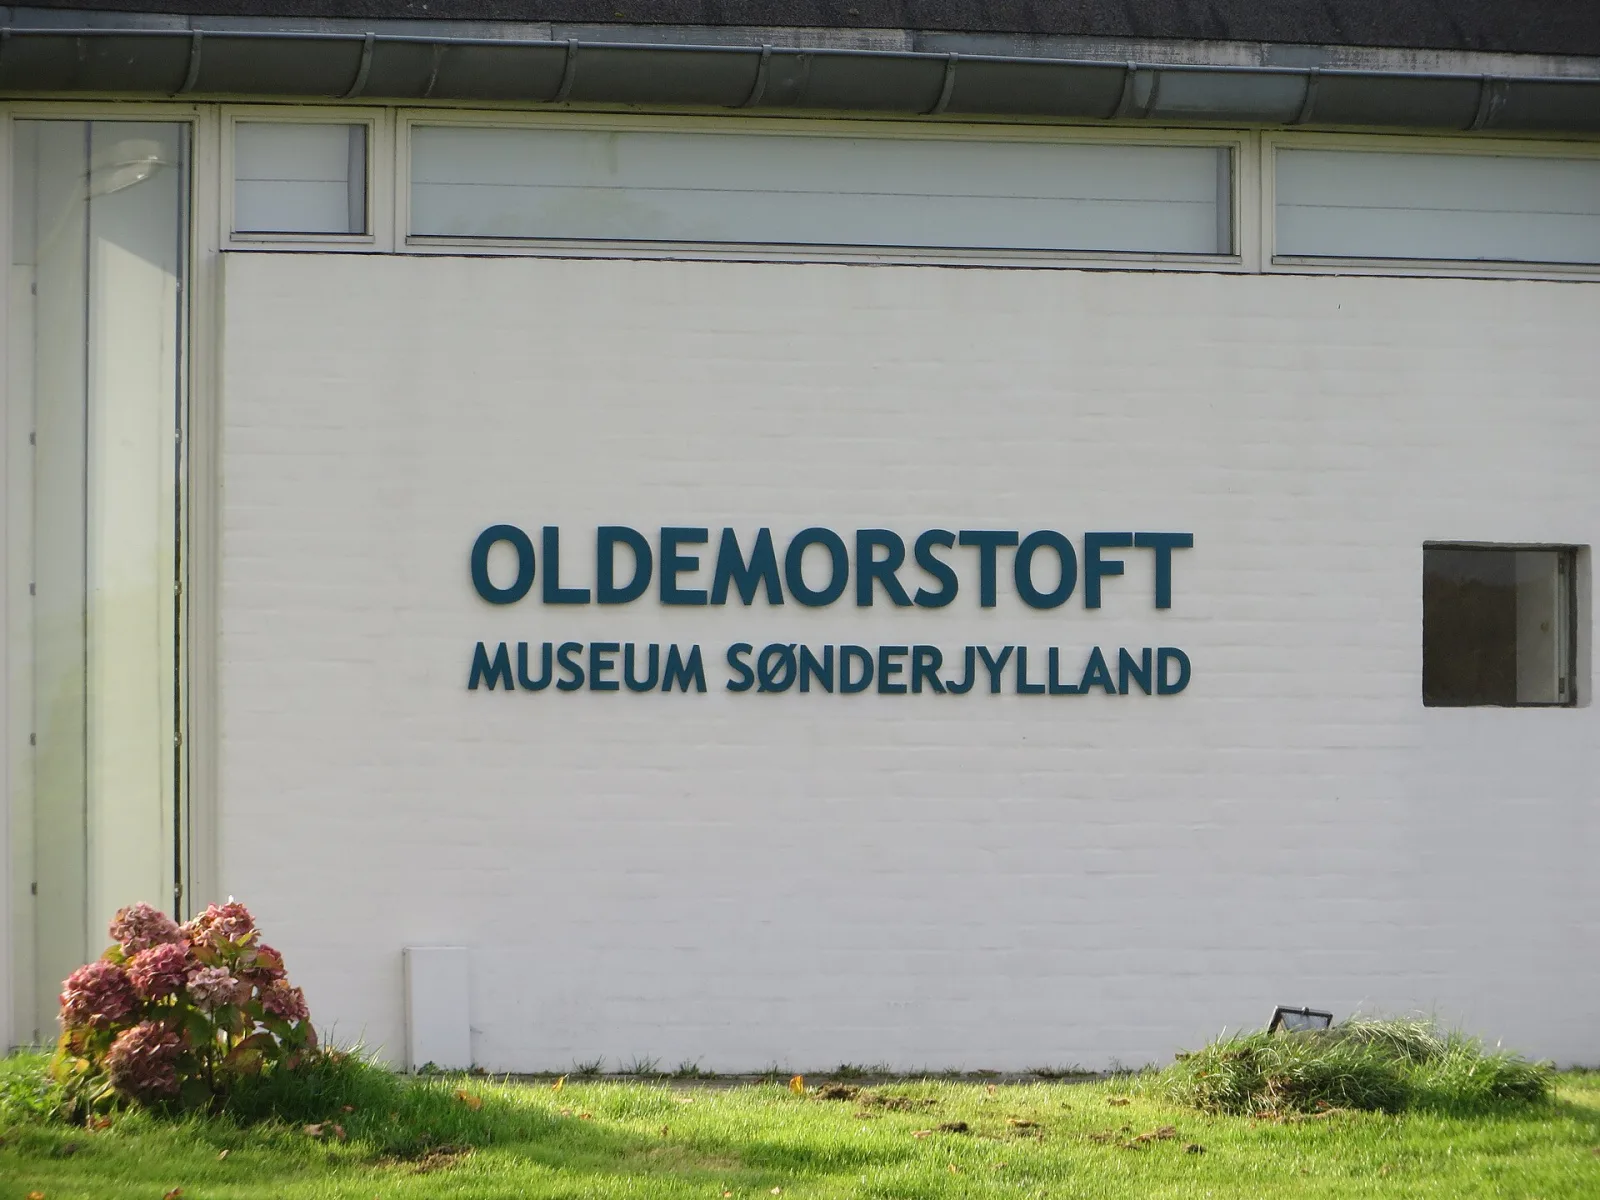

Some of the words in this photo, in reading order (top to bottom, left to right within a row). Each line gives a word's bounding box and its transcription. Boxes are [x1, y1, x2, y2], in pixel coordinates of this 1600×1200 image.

[470, 525, 1194, 611] OLDEMORSTOFT
[468, 641, 707, 694] MUSEUM
[726, 642, 1192, 697] SØNDERJYLLAND
